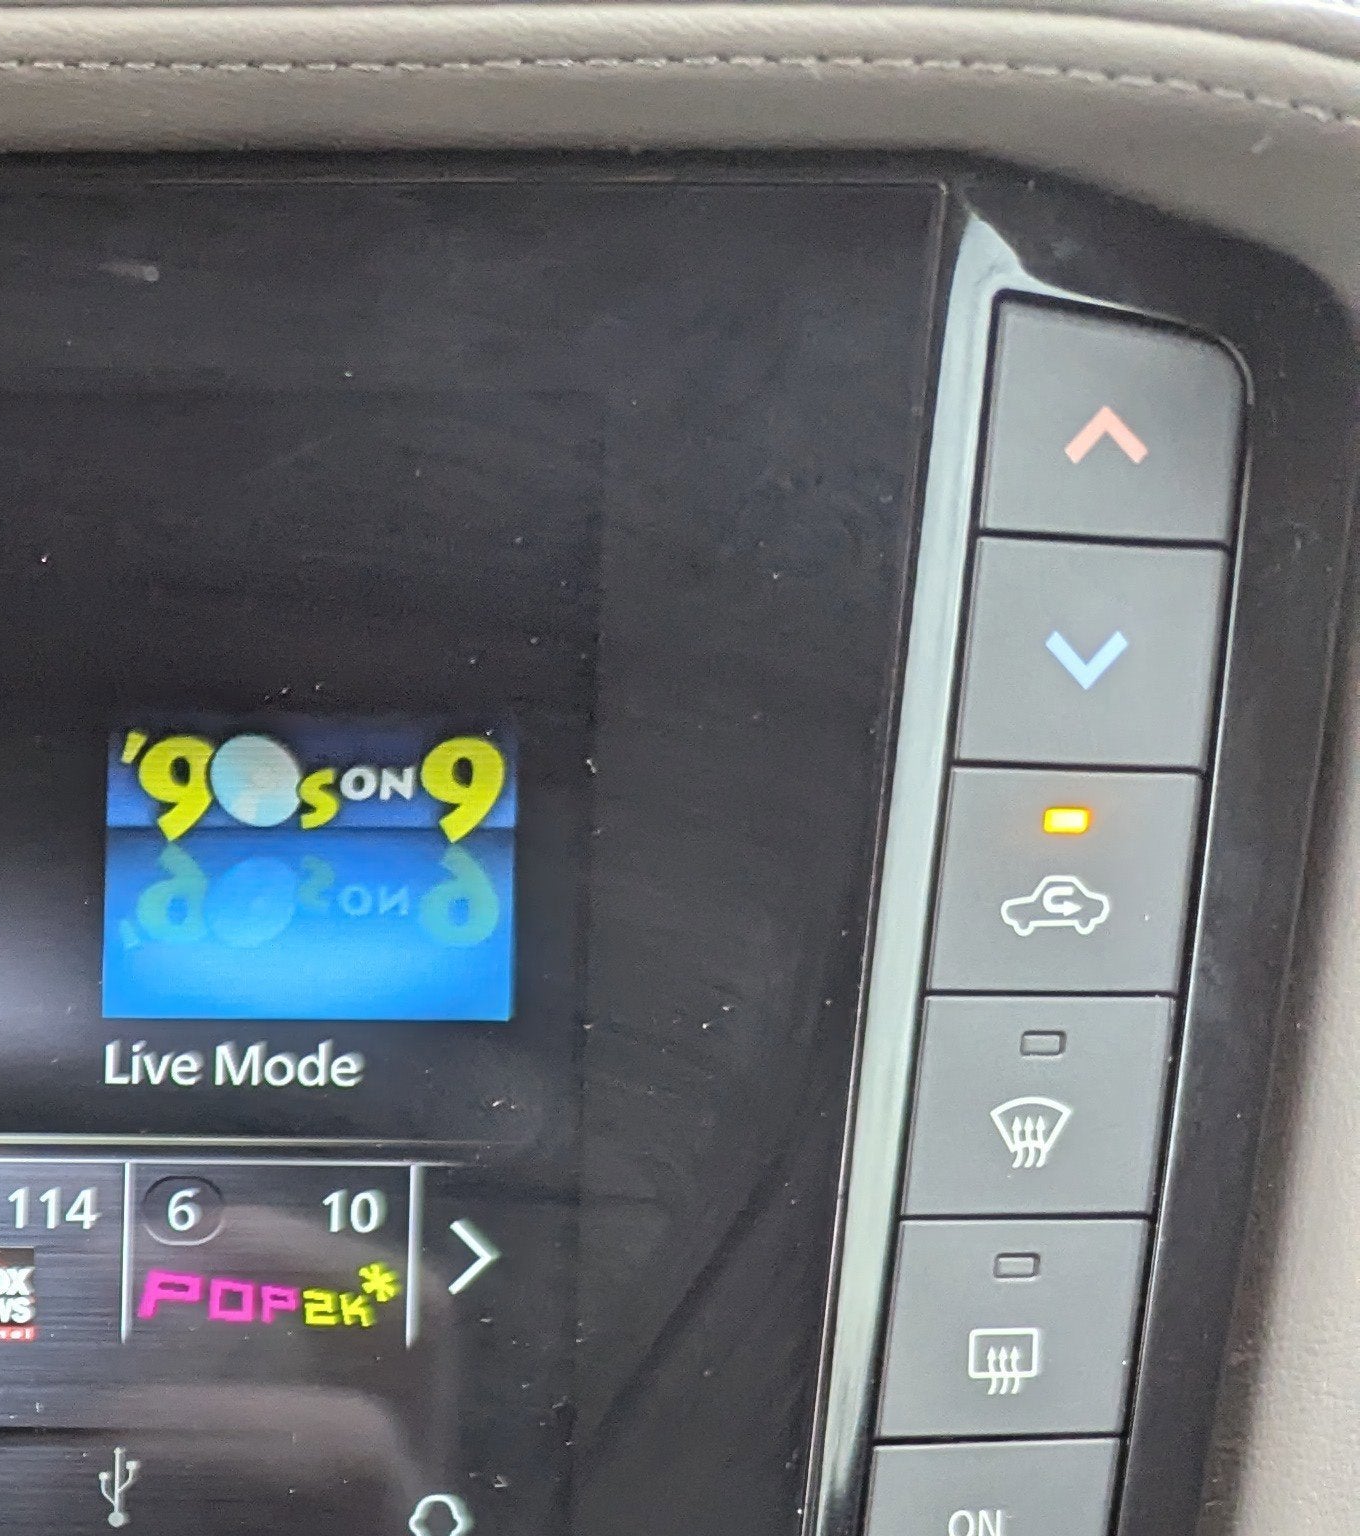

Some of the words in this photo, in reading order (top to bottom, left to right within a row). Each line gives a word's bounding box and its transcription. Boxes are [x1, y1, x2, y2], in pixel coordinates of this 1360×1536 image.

[340, 766, 416, 800] ON
[420, 736, 506, 843] 9
[103, 1040, 203, 1087] Live
[214, 1041, 365, 1088] Mode
[7, 1186, 99, 1230] 114
[166, 1188, 198, 1232] 6
[322, 1189, 385, 1234] 10
